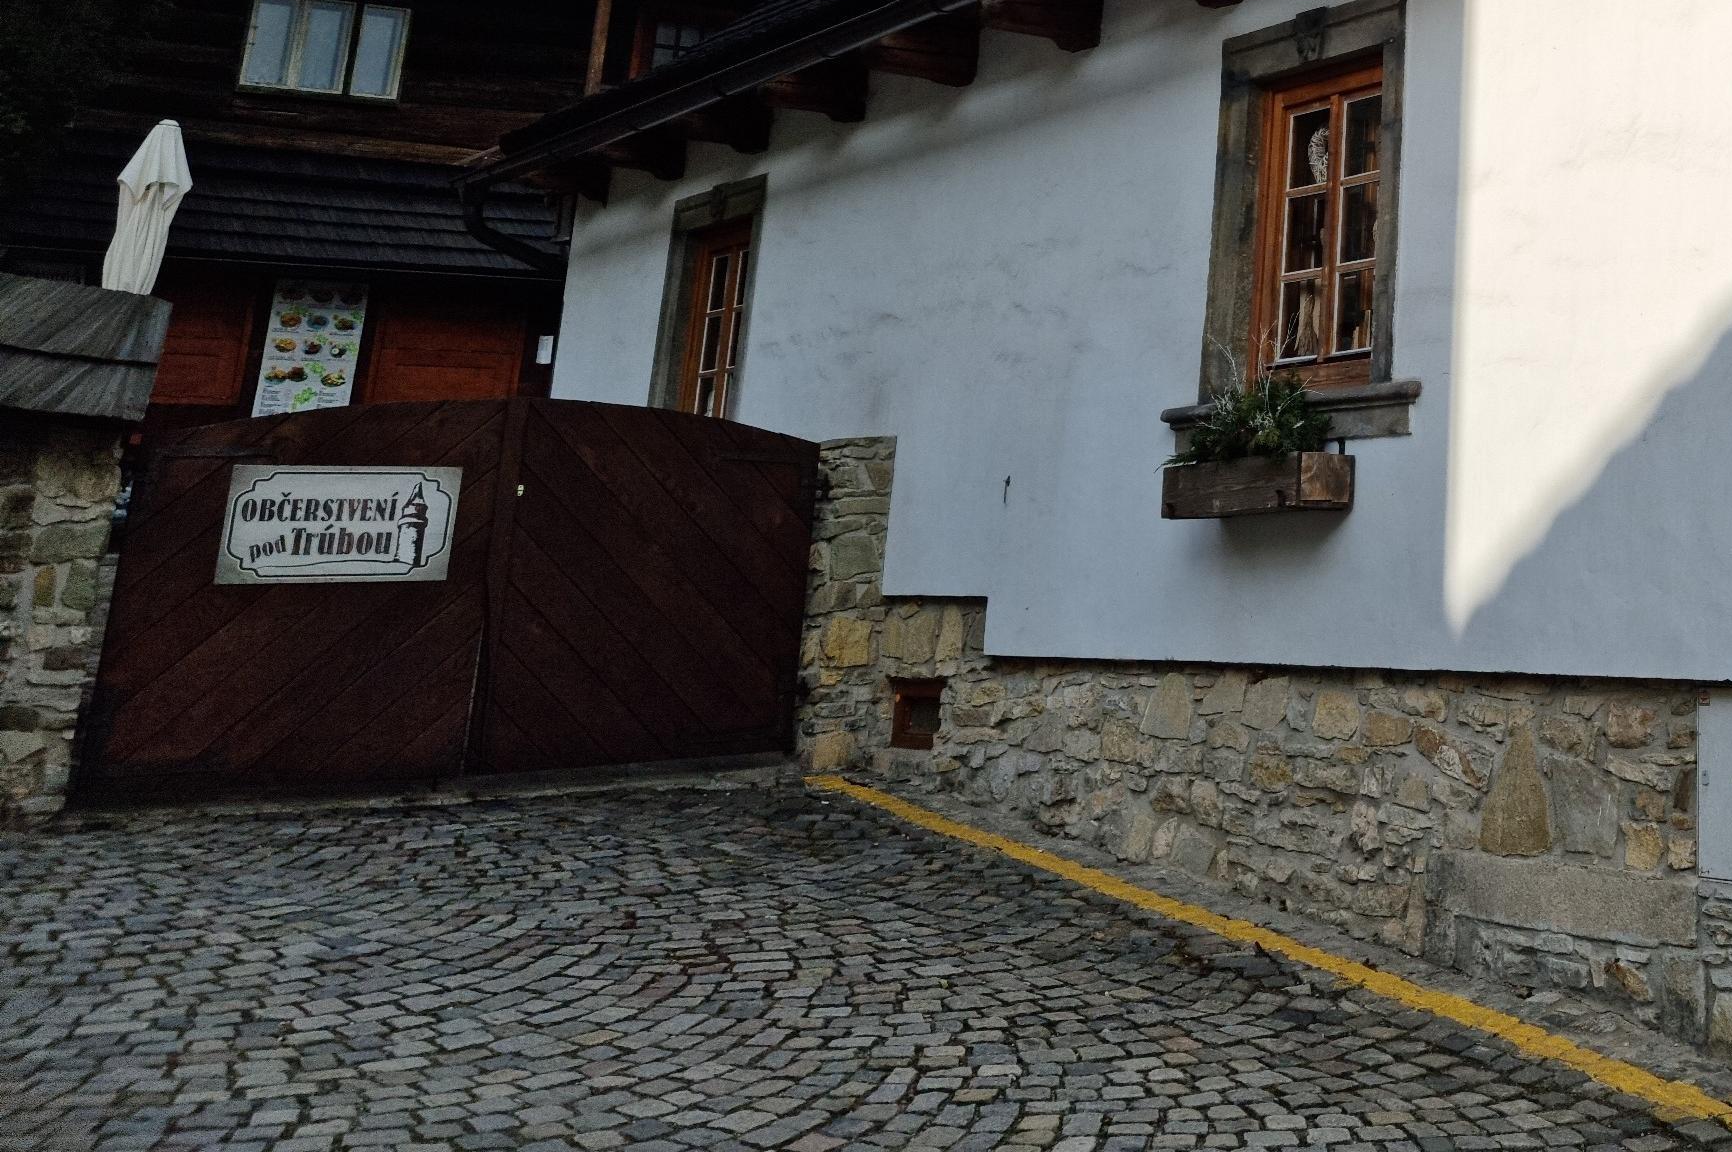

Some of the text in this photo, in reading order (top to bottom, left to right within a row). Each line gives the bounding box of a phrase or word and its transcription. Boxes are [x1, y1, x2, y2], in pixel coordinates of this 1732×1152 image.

[241, 491, 399, 523] OBČERSTVENÍ
[248, 524, 393, 564] pod Trúbou
